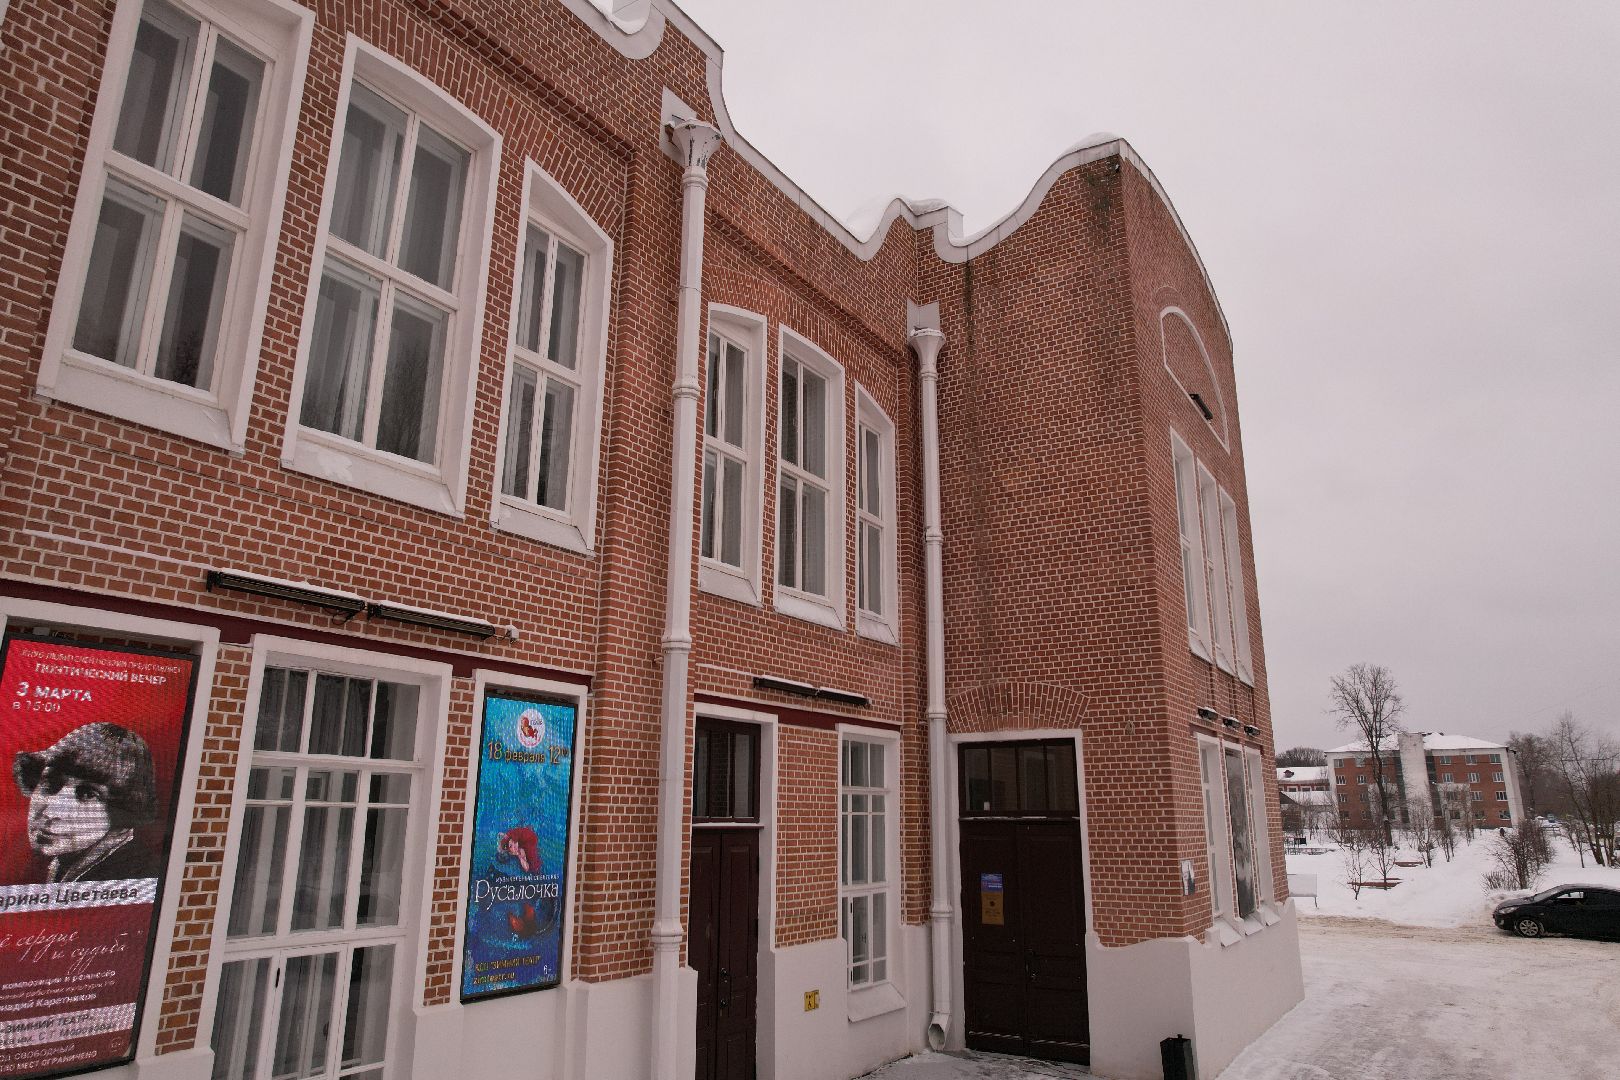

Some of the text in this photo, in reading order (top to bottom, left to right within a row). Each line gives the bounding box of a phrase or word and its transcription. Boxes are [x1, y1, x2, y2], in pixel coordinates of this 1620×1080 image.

[35, 662, 167, 685] ПОЭТИЧЕСКИЙ ВЕЧЕР
[16, 681, 92, 702] 3 МАРТА
[25, 700, 61, 712] 15:00
[488, 741, 503, 760] 18
[505, 746, 546, 764] февраля
[55, 887, 138, 905] Цветаева
[474, 879, 559, 910] Русалочка
[16, 928, 79, 963] сердце
[2, 978, 62, 990] композиции
[14, 1042, 75, 1060] СВОБОДНЫЙ
[17, 1060, 39, 1070] МЕСТ
[41, 1050, 97, 1066] ОГРАНИЧЕНО
